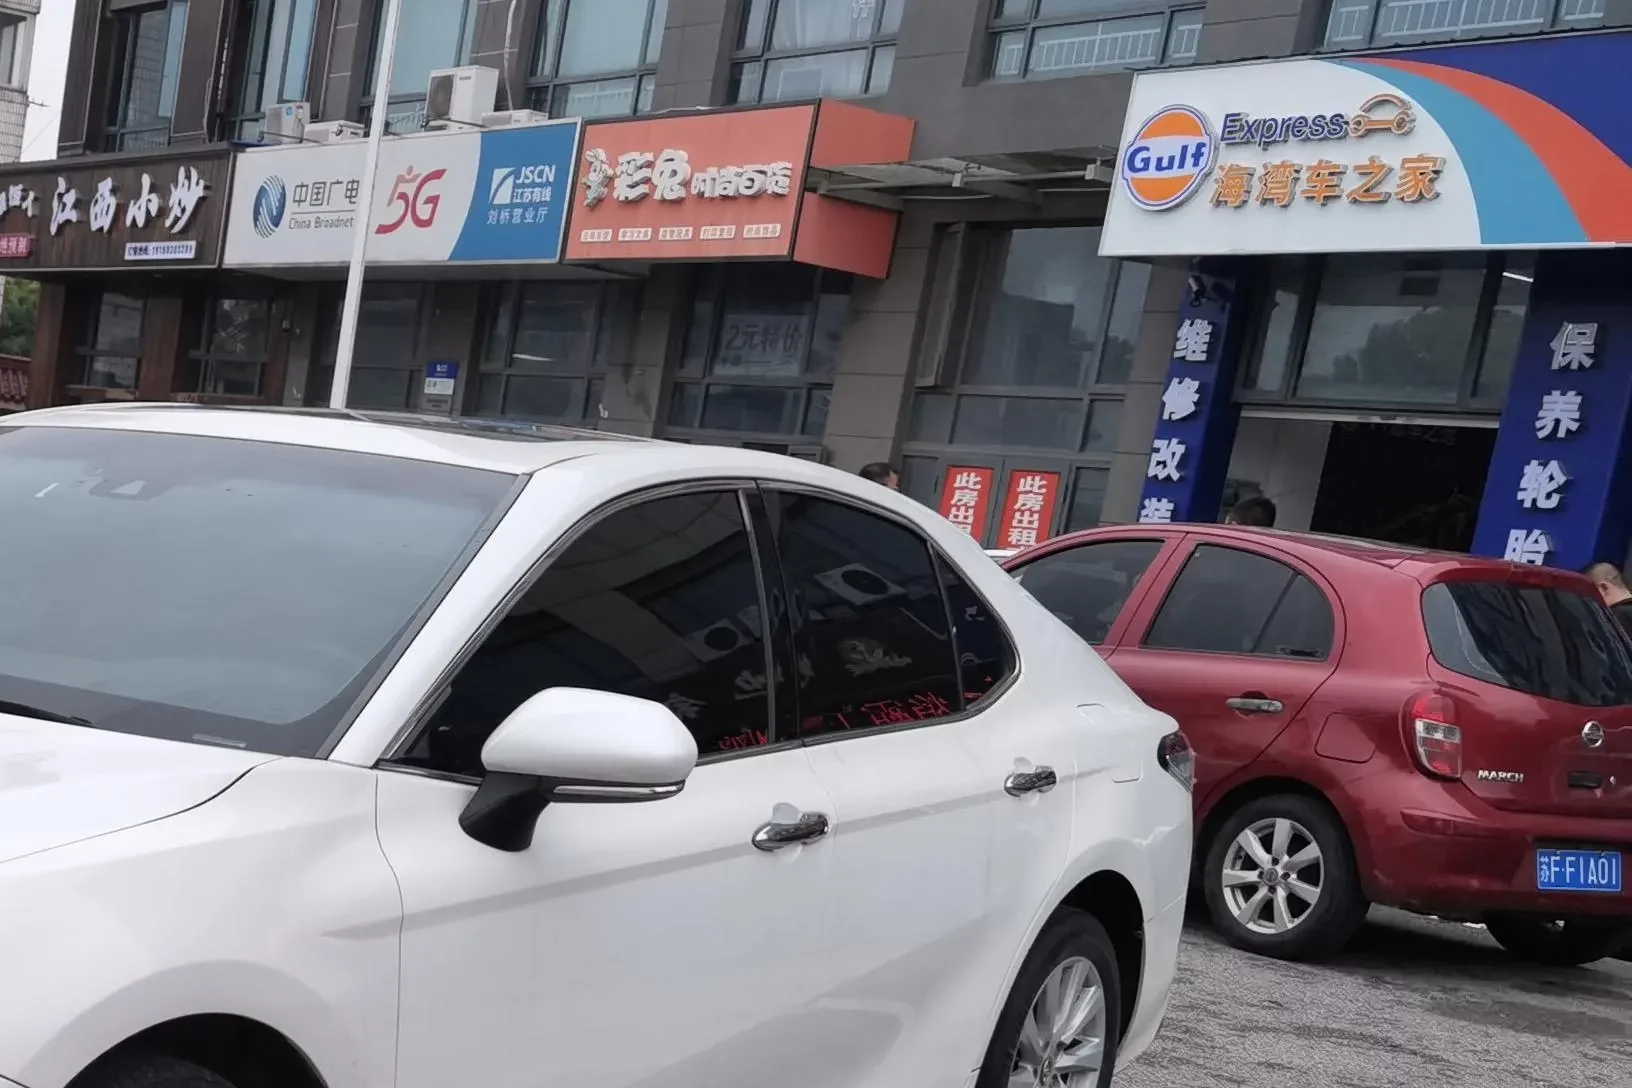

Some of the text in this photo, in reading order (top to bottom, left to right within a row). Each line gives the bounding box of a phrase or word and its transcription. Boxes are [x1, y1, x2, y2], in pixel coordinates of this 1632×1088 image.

[1219, 112, 1347, 150] Express
[515, 164, 556, 184] JSCN
[1125, 139, 1207, 176] Gulf
[292, 179, 360, 207] 中国广电
[512, 186, 552, 203] 江苏有线
[1209, 154, 1447, 208] 海湾车之家
[49, 165, 205, 236] 江西小炒
[374, 165, 448, 235] 5G
[486, 206, 548, 225] 刘桥营业厅
[288, 216, 354, 230] China Broadnet
[1139, 318, 1215, 523] 维修改装
[1504, 321, 1599, 566] 保养轮胎
[1006, 475, 1048, 550] 此房出租
[1477, 769, 1524, 783] MARCH
